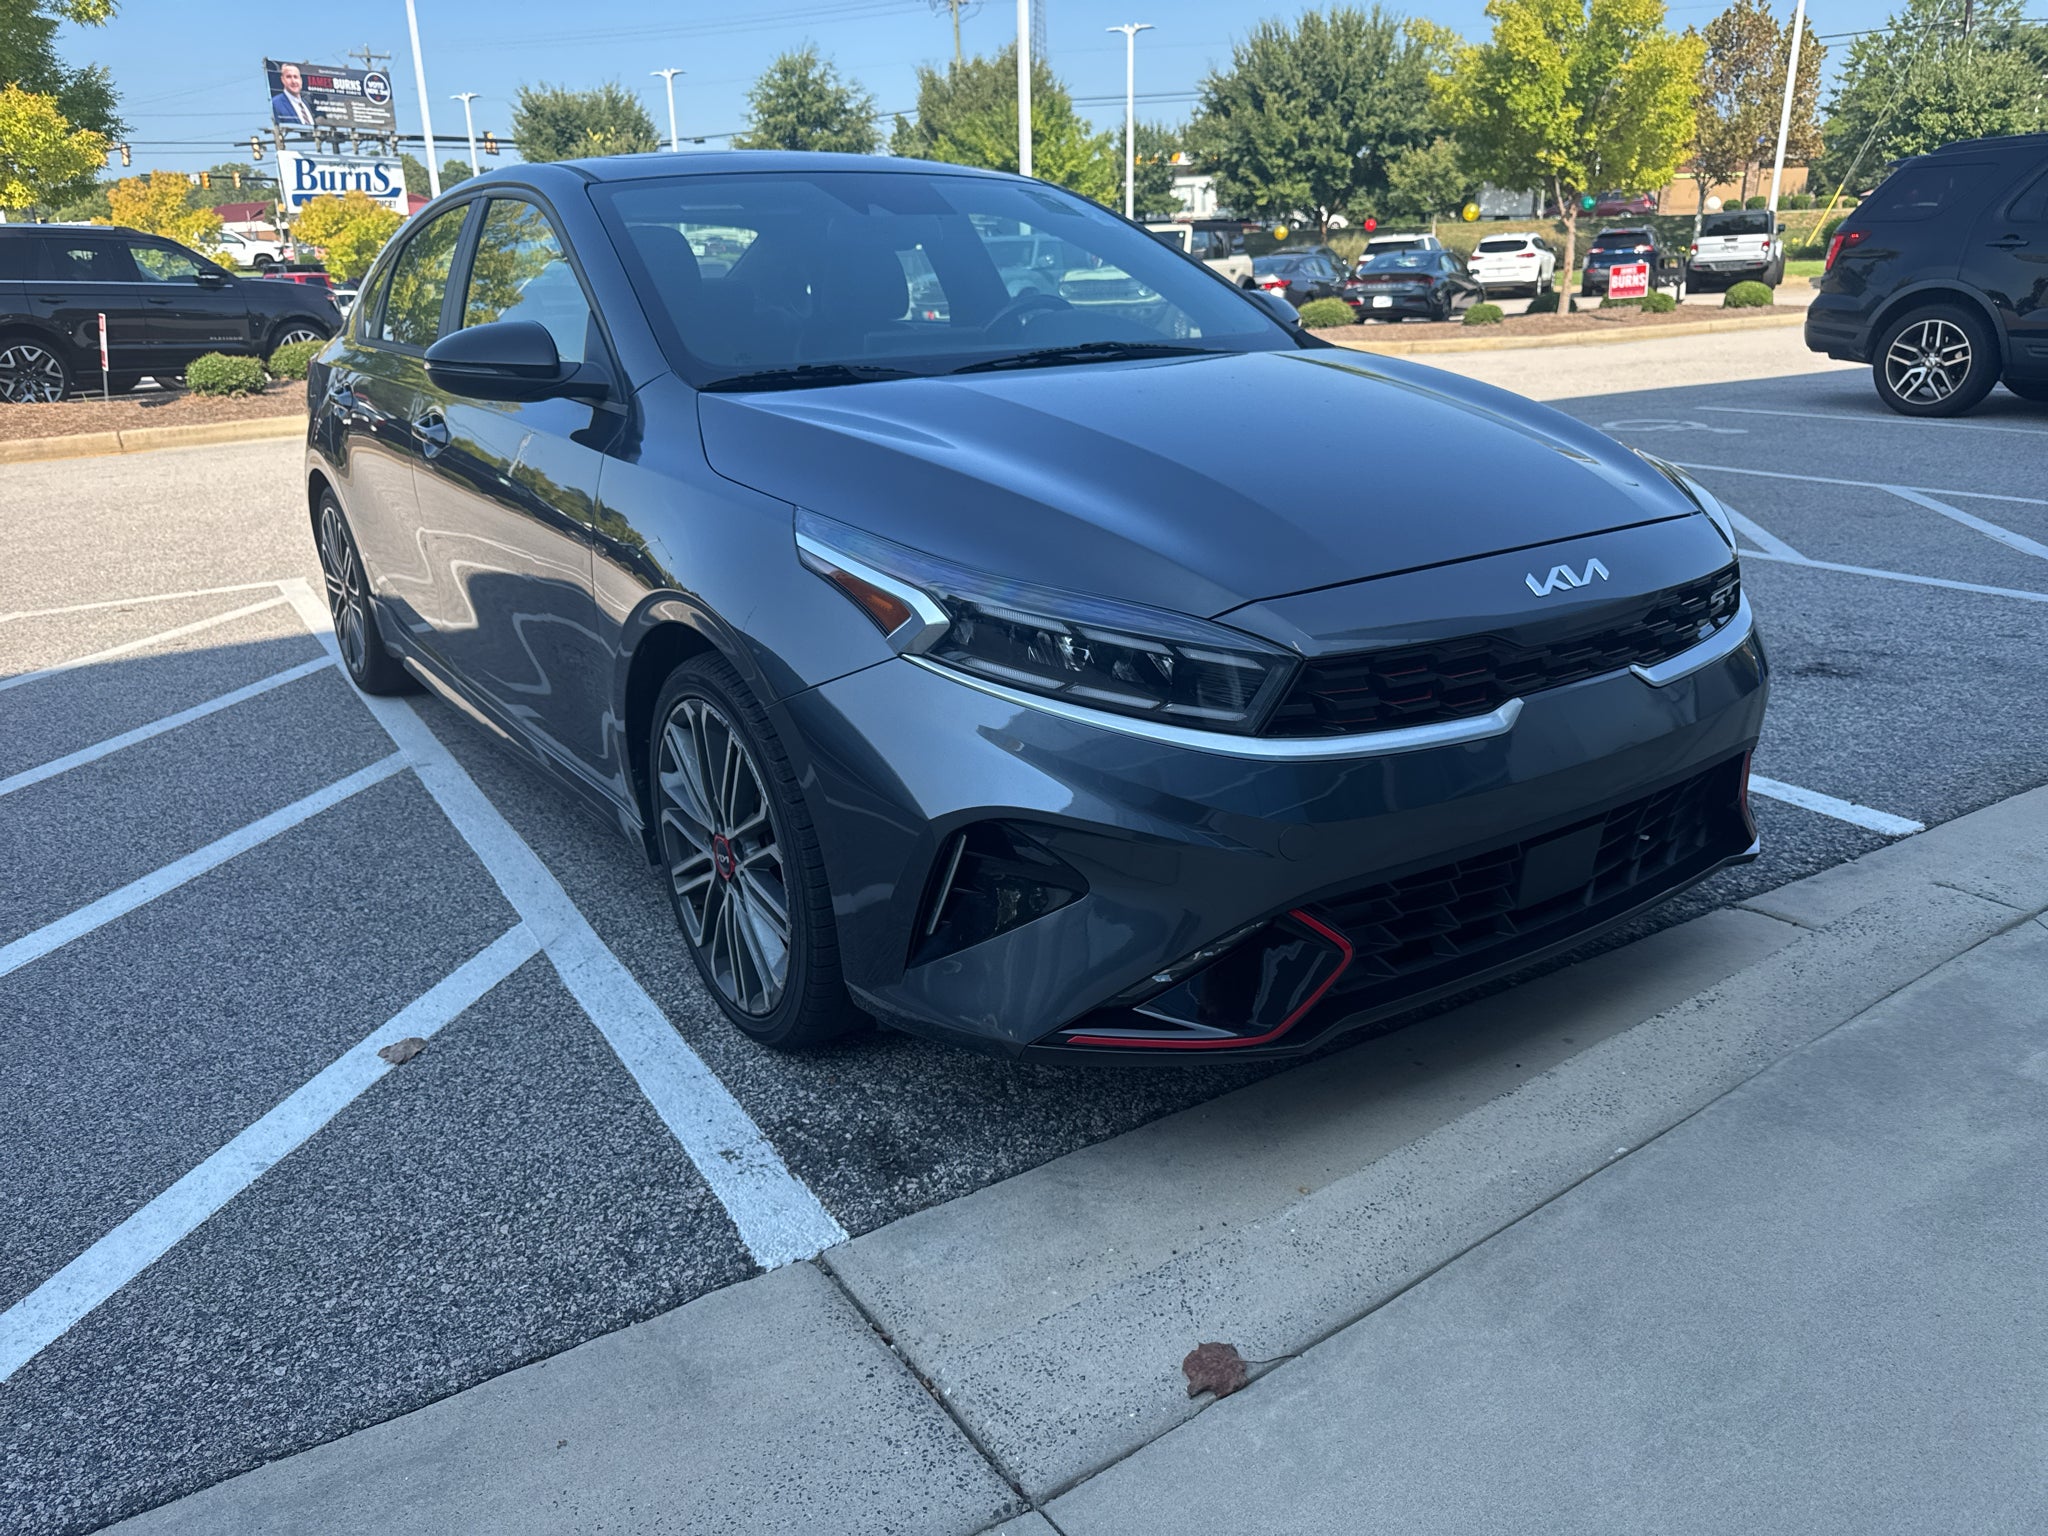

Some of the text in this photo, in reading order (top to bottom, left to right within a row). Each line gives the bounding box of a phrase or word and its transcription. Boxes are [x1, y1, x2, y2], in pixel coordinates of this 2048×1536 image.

[307, 76, 361, 91] JAMES BURNS
[368, 82, 384, 90] VOTE
[1612, 272, 1645, 288] BURNS
[1525, 557, 1610, 598] KIA
